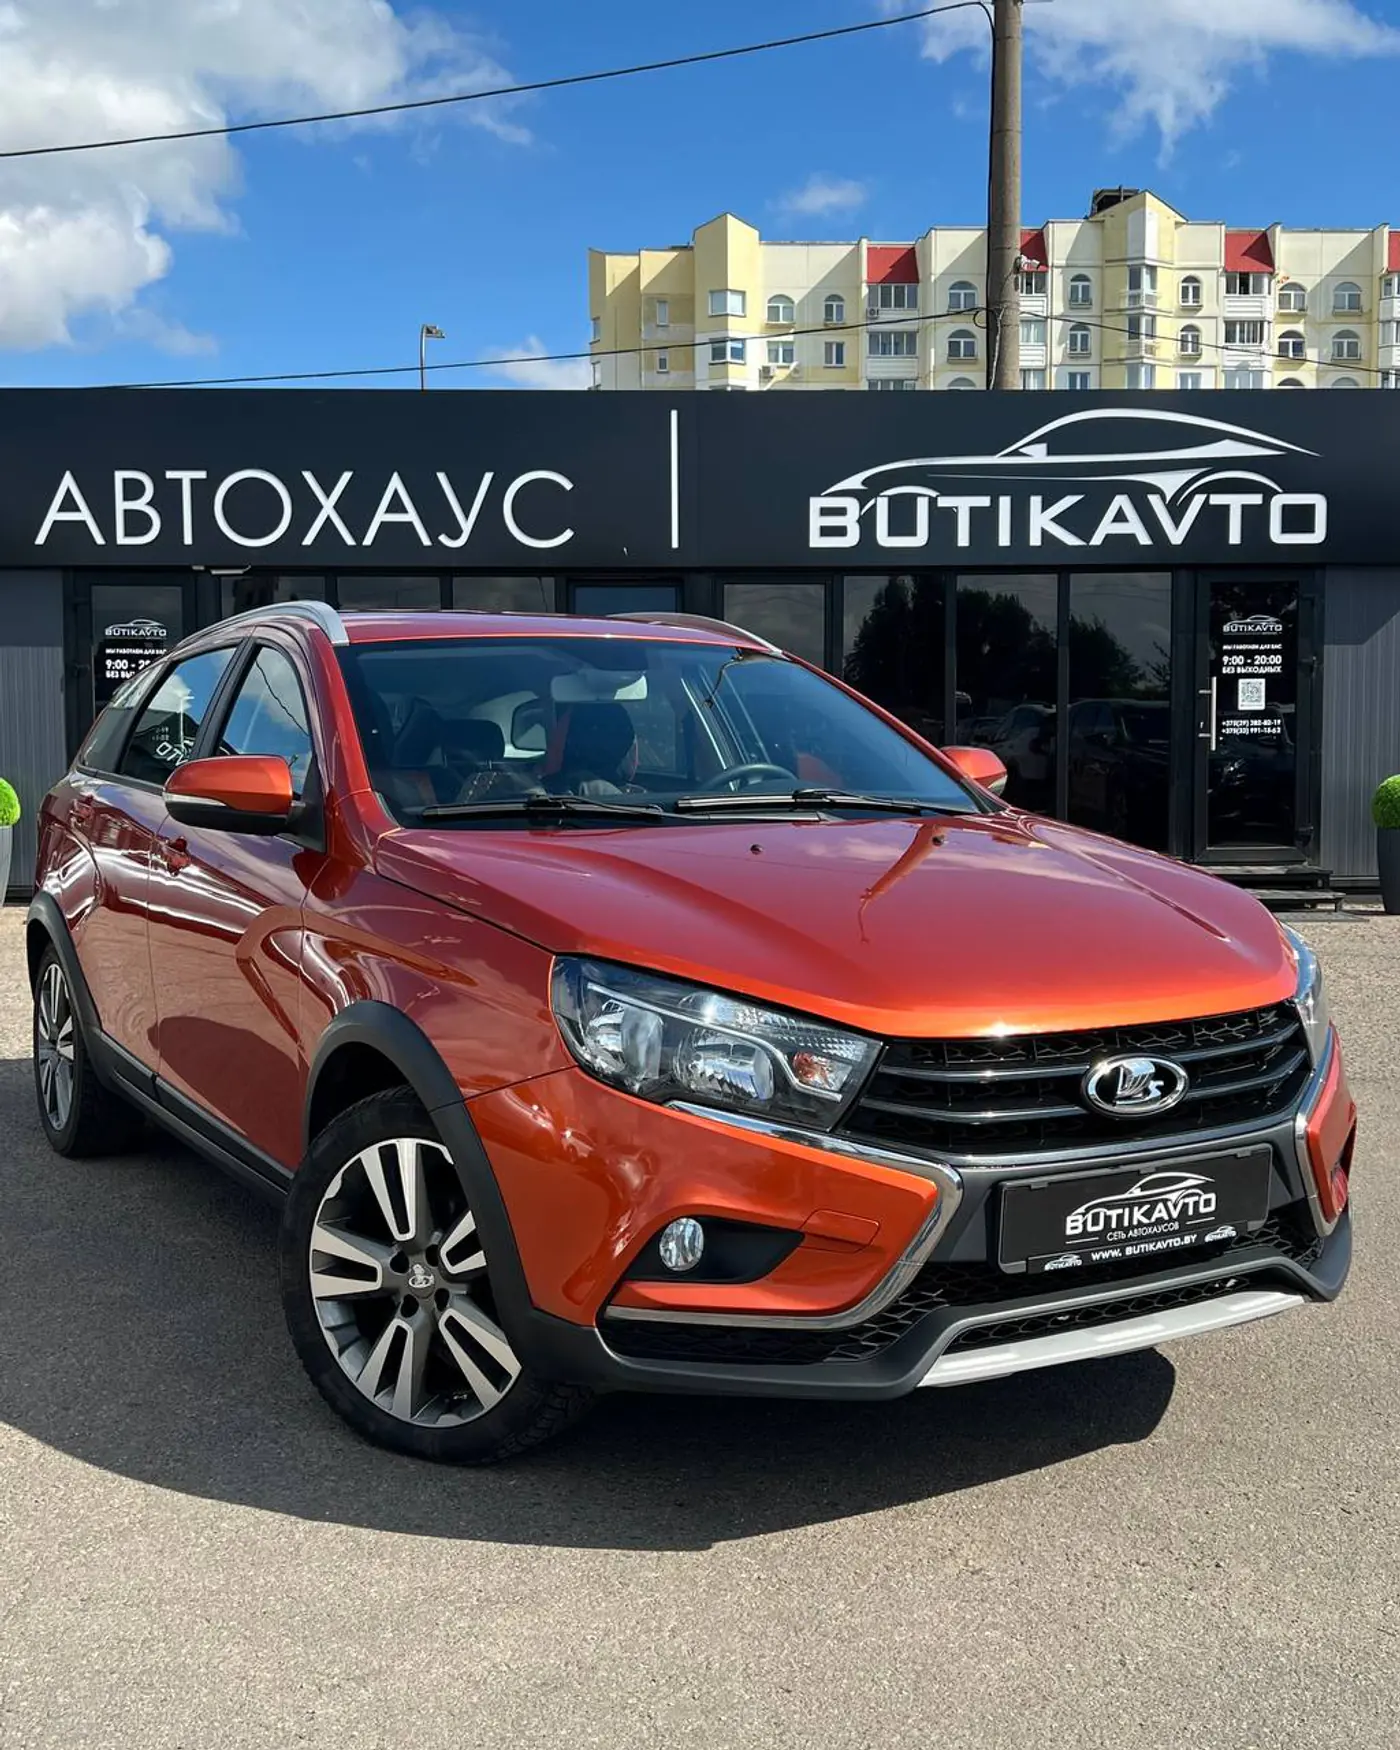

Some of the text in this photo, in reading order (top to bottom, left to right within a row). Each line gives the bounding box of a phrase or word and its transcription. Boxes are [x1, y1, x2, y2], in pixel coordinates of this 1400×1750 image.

[34, 468, 576, 549] АВТОХАУС
[808, 491, 1328, 549] BUTIKAVTO
[105, 628, 167, 637] BUTIKAVTO
[1222, 624, 1283, 632] BUTIKAVTO
[105, 659, 129, 670] 9:00
[1222, 655, 1244, 666] 9:00
[1254, 655, 1282, 665] 20:00
[105, 670, 119, 679] БЕЗ
[1222, 666, 1282, 674] БЕЗ ВЫХОДНЫХ
[1065, 1192, 1217, 1236] BUTIKAVTO
[1106, 1221, 1180, 1242] СЕТЬ АВТОХАУСОВ
